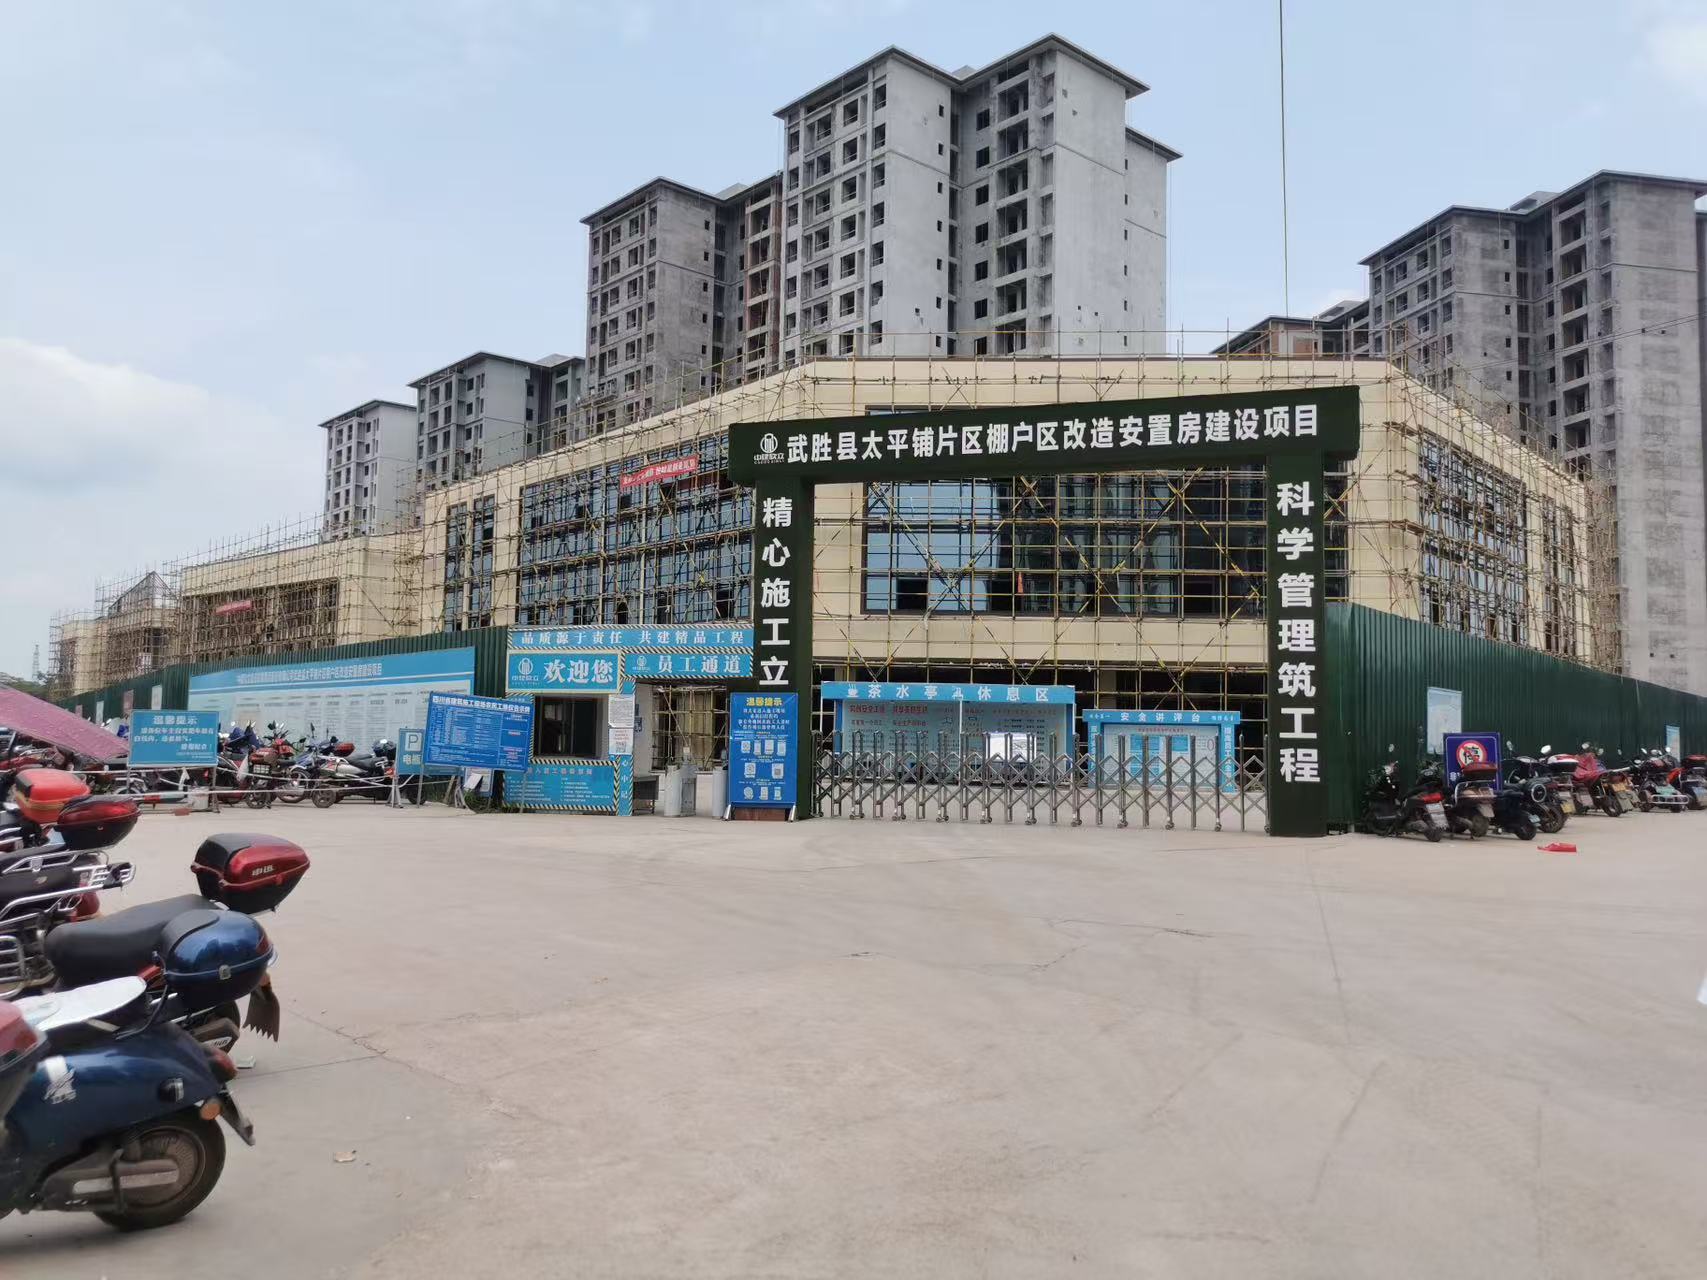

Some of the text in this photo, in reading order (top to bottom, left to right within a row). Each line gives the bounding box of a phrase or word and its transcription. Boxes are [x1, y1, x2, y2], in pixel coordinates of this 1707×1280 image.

[787, 404, 1318, 464] 武胜县太平铺片区棚户区改造安置房建设项目
[759, 496, 793, 686] 精心施工立
[521, 629, 745, 645] 品质源于责任 共建精品工程
[1276, 481, 1321, 783] 科学管理筑工程
[543, 658, 614, 685] 欢迎您
[657, 654, 742, 675] 员工通道
[868, 684, 1049, 702] 茶水亭 休息区
[1120, 712, 1201, 723] 安全讲评台
[408, 734, 419, 749] P
